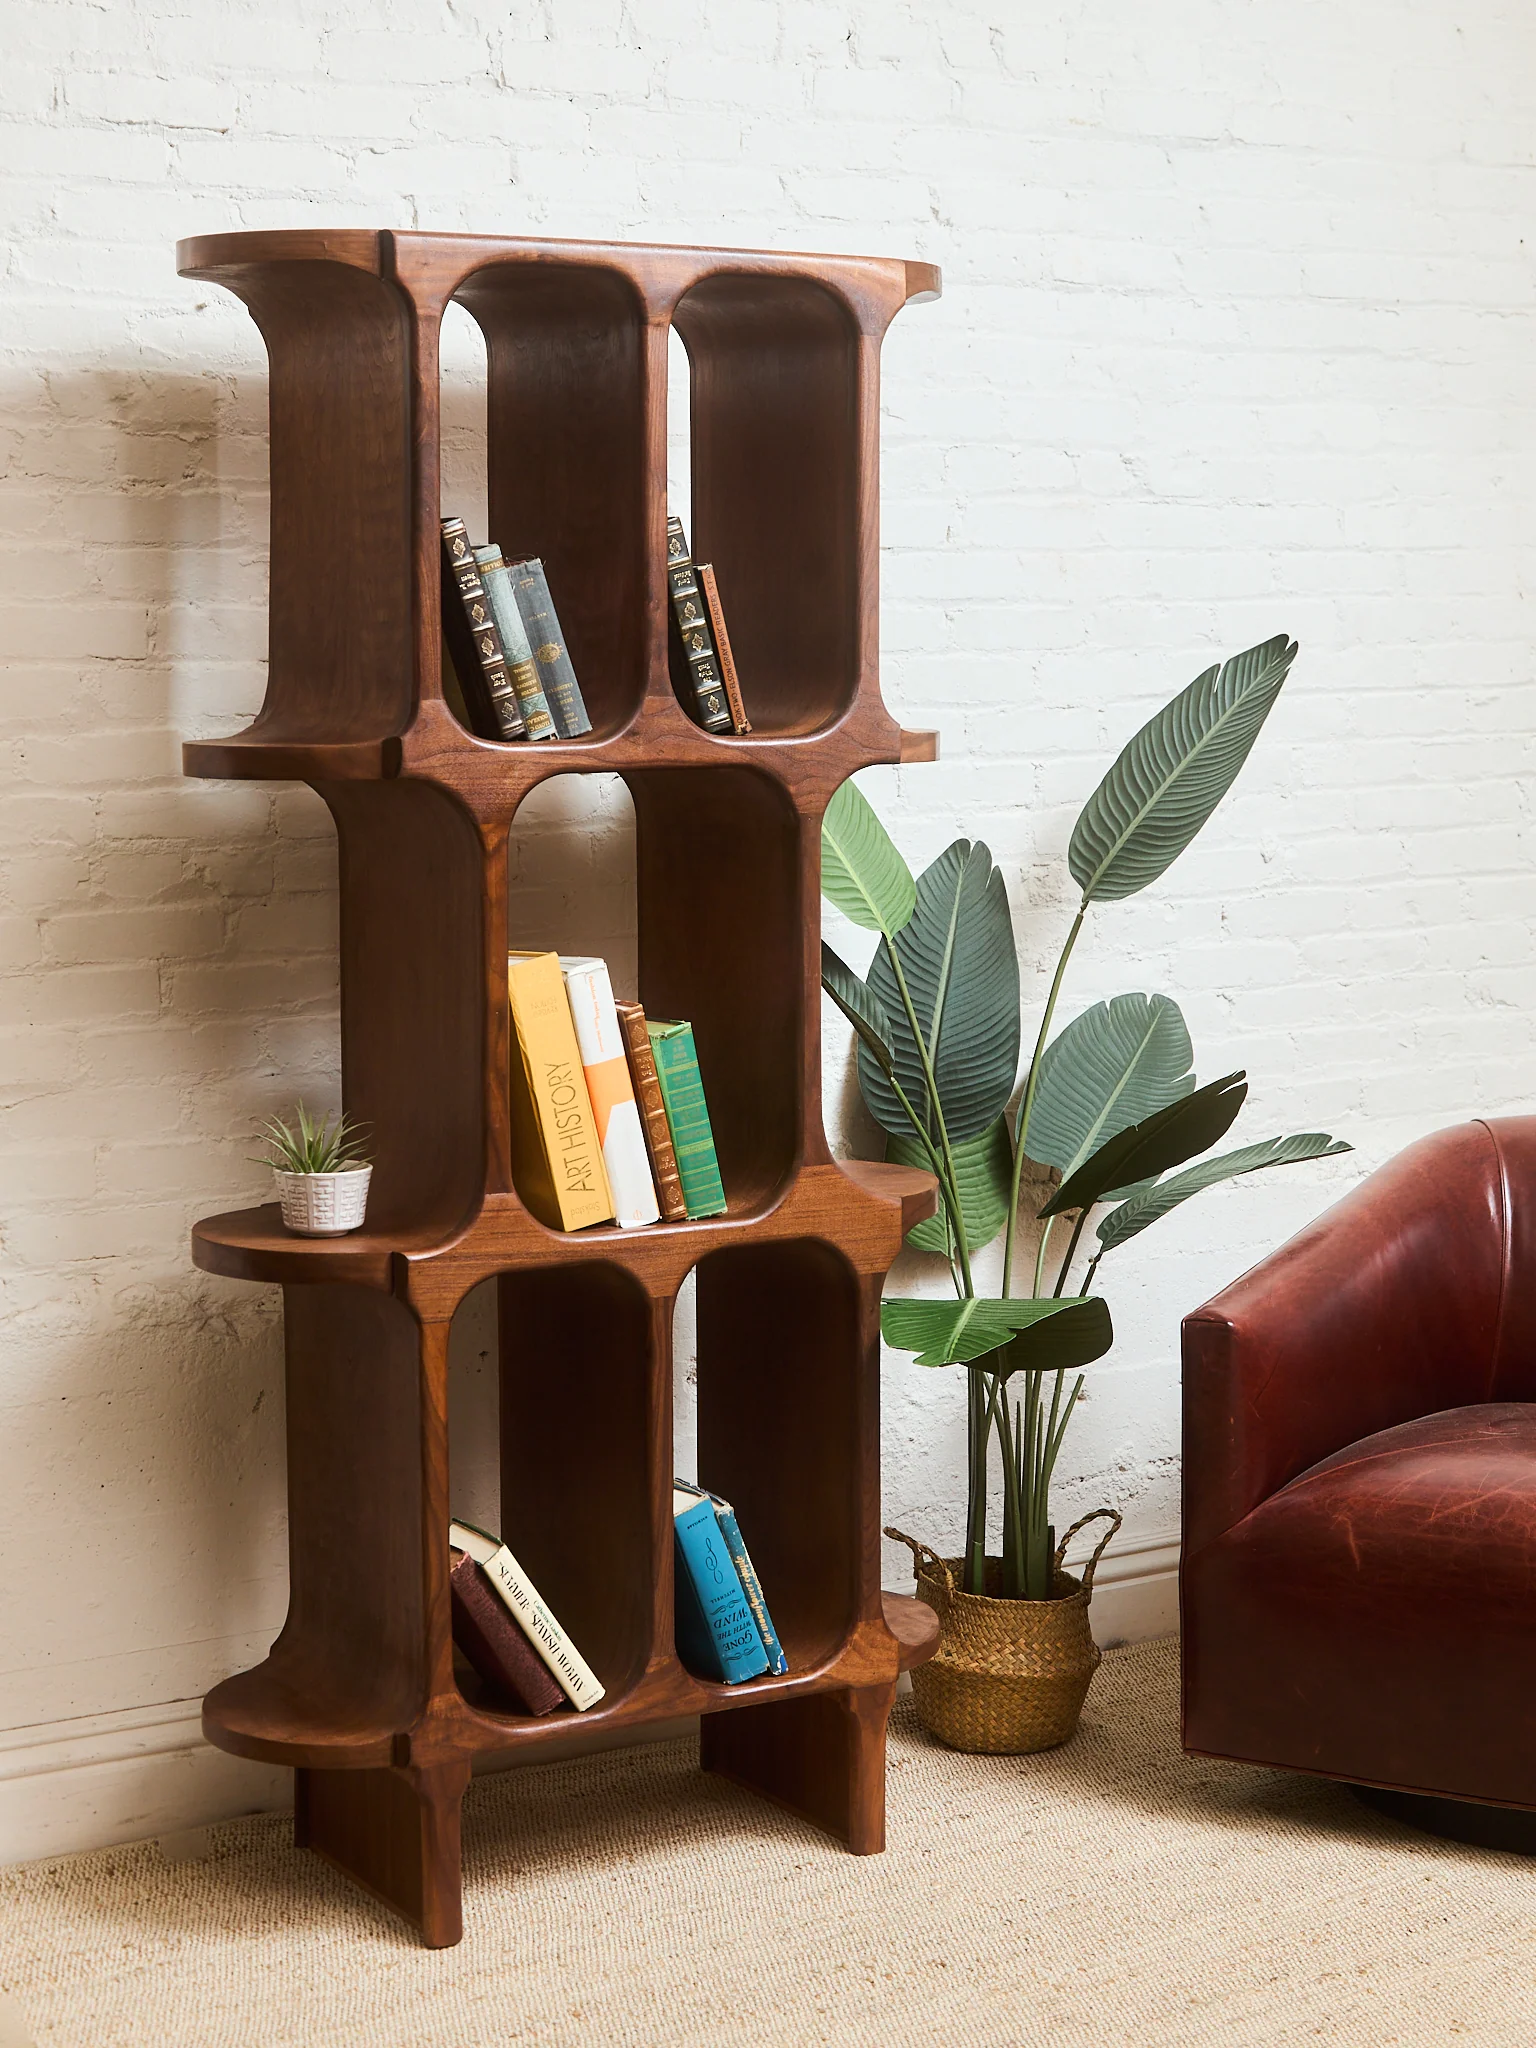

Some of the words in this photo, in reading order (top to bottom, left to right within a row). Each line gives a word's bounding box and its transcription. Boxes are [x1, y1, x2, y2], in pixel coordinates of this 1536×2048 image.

[717, 627, 726, 646] BASIC
[543, 1058, 586, 1151] HISTORY
[559, 1153, 595, 1195] ART
[711, 1606, 748, 1630] WIND
[731, 1620, 752, 1634] WITH
[715, 1629, 732, 1641] THE
[719, 1628, 754, 1653] GONE
[762, 1631, 773, 1646] the
